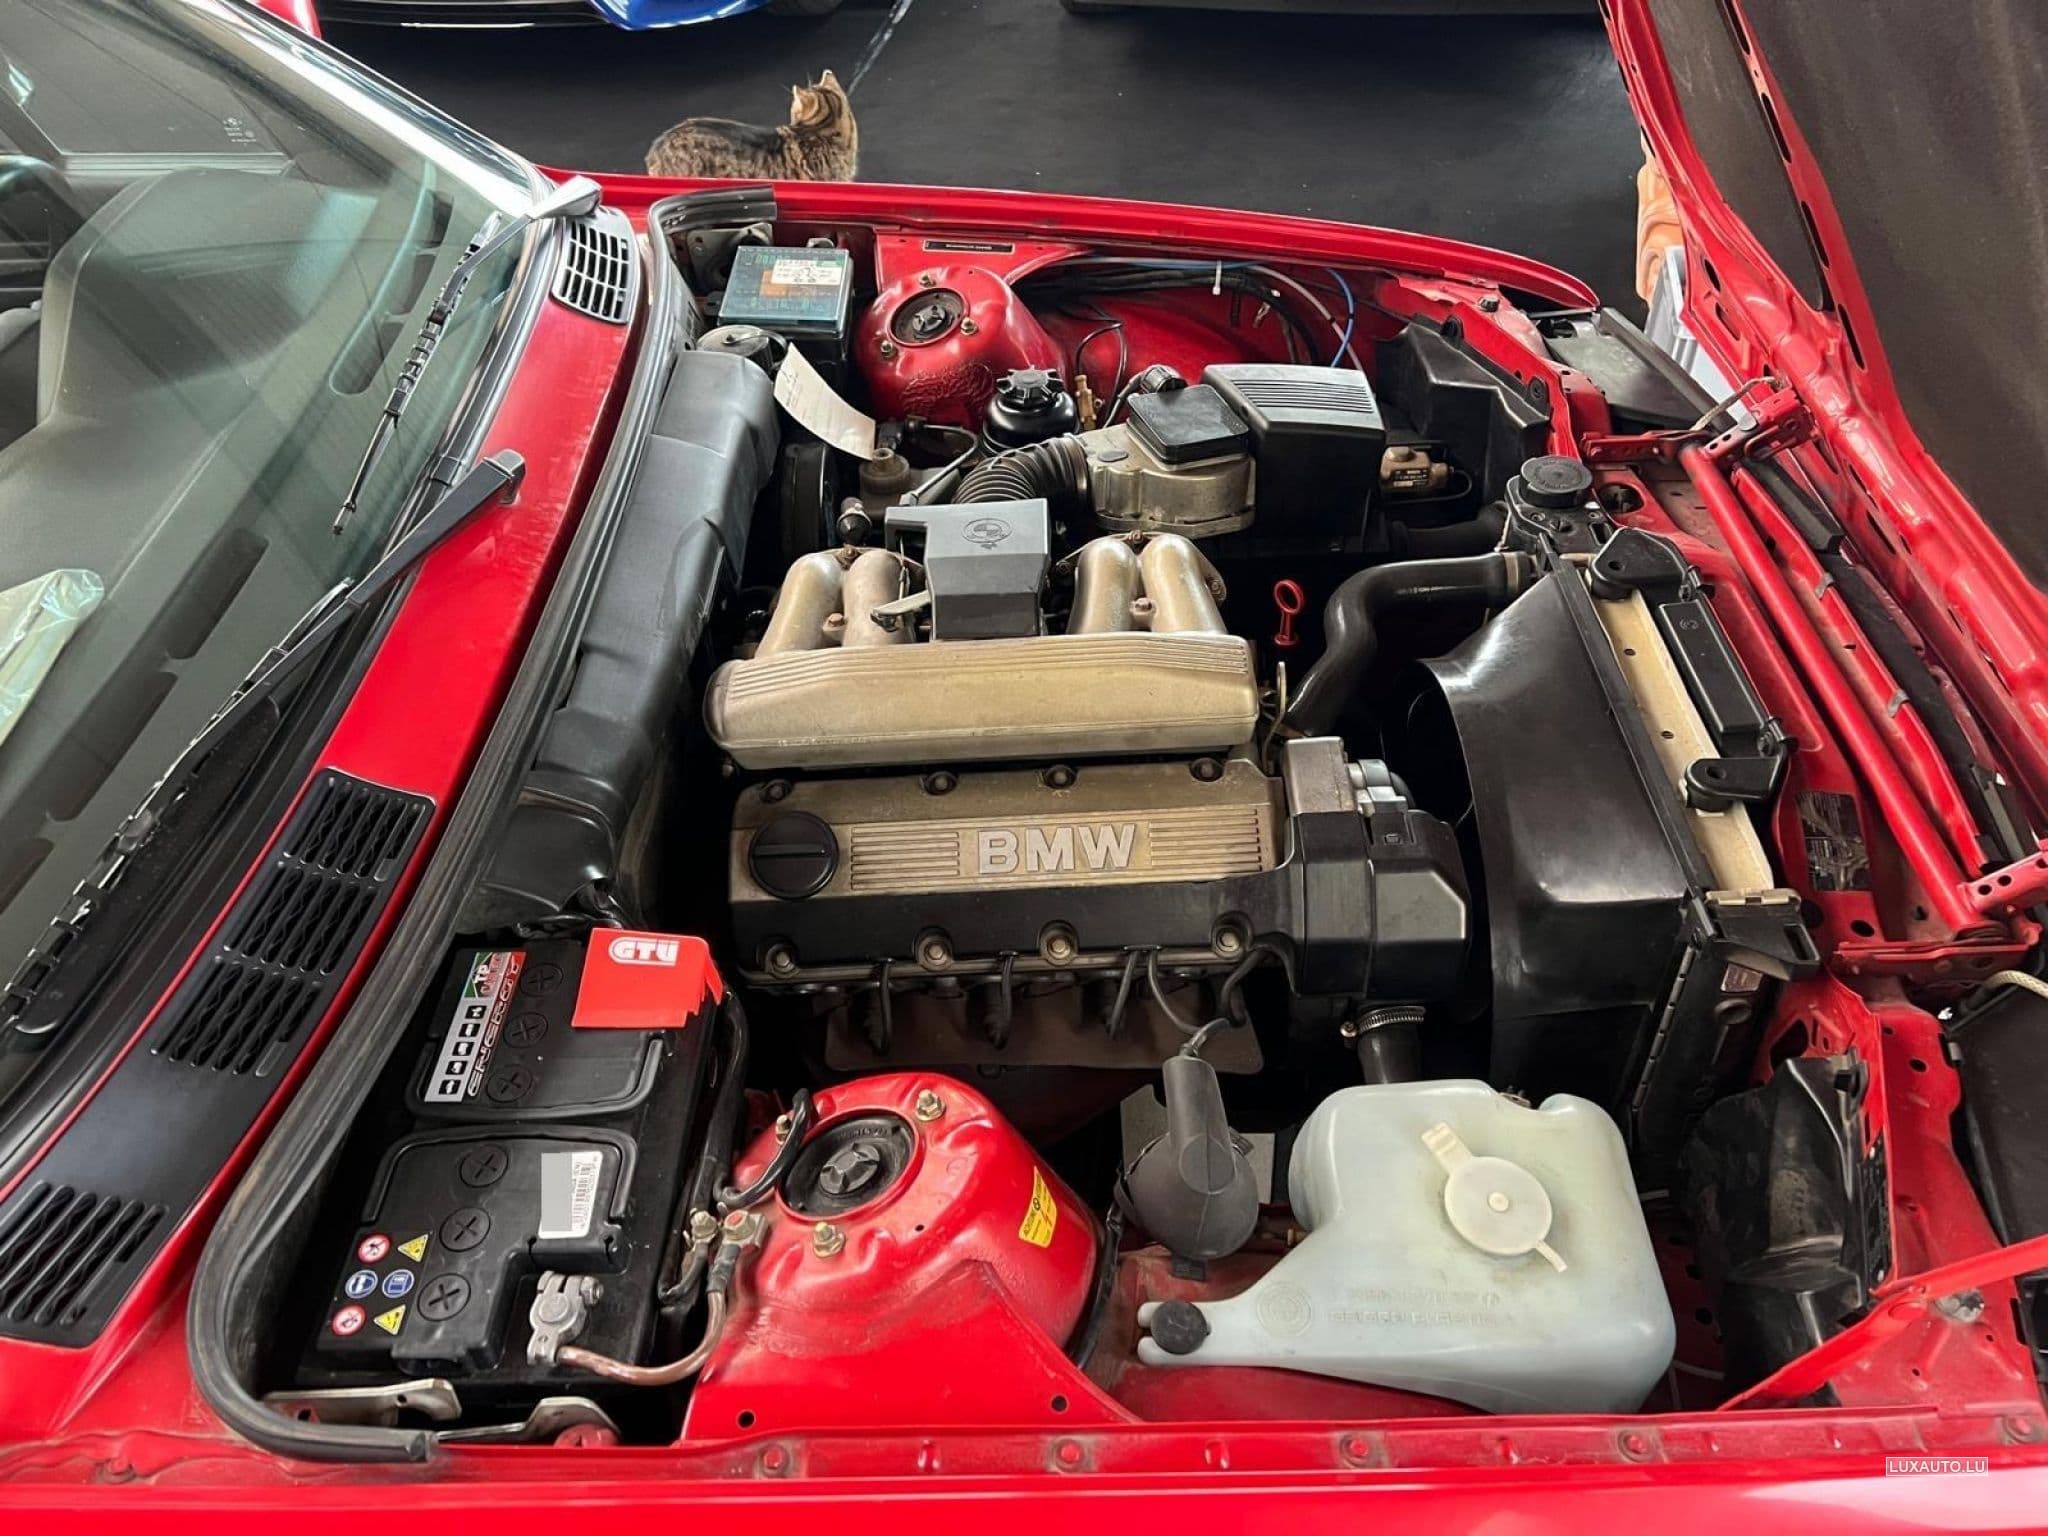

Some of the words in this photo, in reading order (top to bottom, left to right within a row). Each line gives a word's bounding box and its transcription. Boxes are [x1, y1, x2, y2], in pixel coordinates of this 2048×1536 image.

[978, 823, 1136, 874] BMW
[610, 938, 678, 965] GTU
[467, 952, 521, 1096] ENERGY
